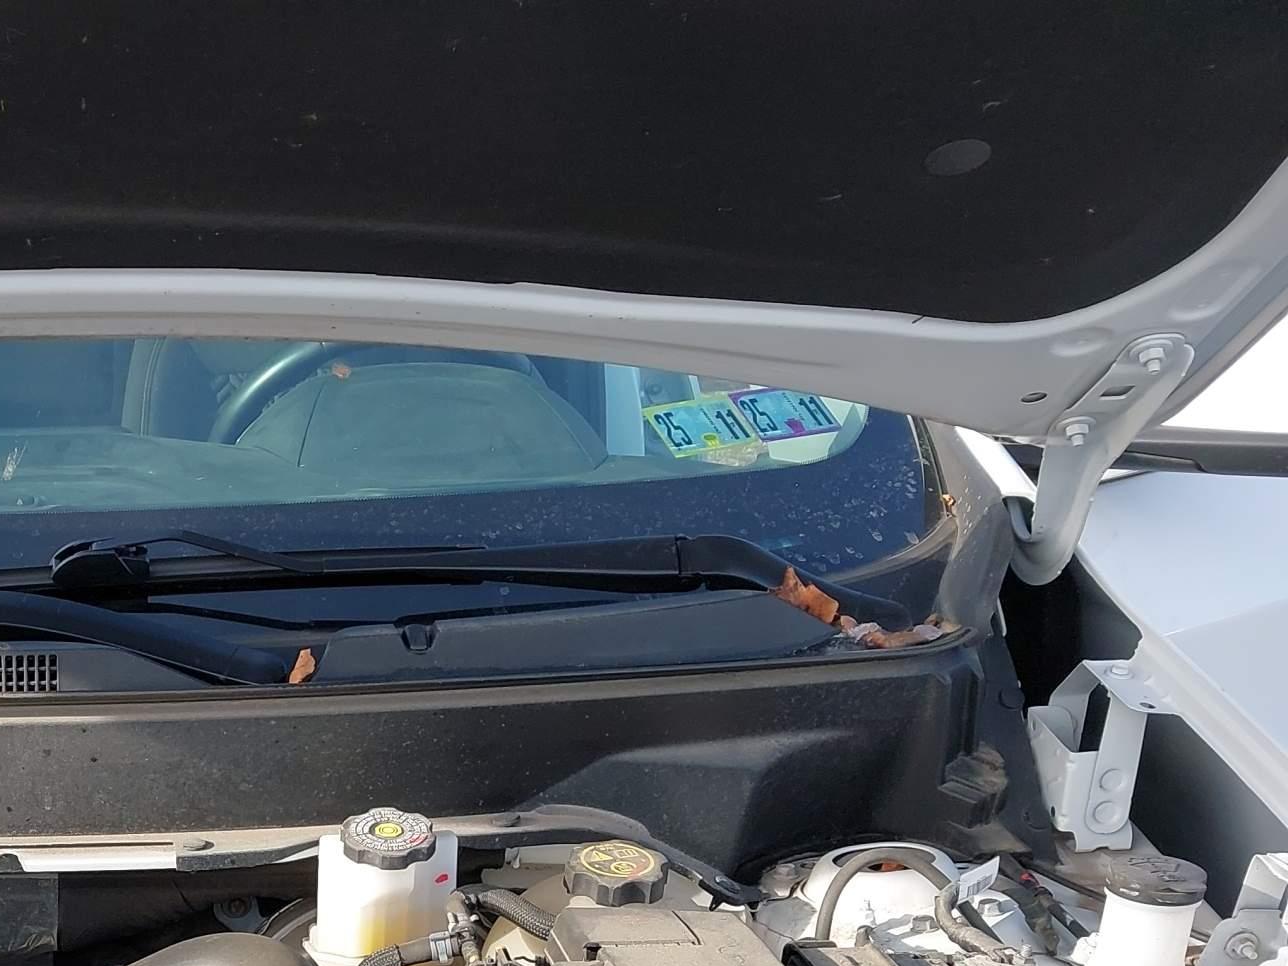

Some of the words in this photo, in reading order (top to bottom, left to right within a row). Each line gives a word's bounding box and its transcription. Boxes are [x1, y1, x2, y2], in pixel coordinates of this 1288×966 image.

[715, 409, 751, 440] 11
[740, 398, 778, 433] 25
[799, 396, 834, 426] 11
[654, 412, 693, 448] 25
